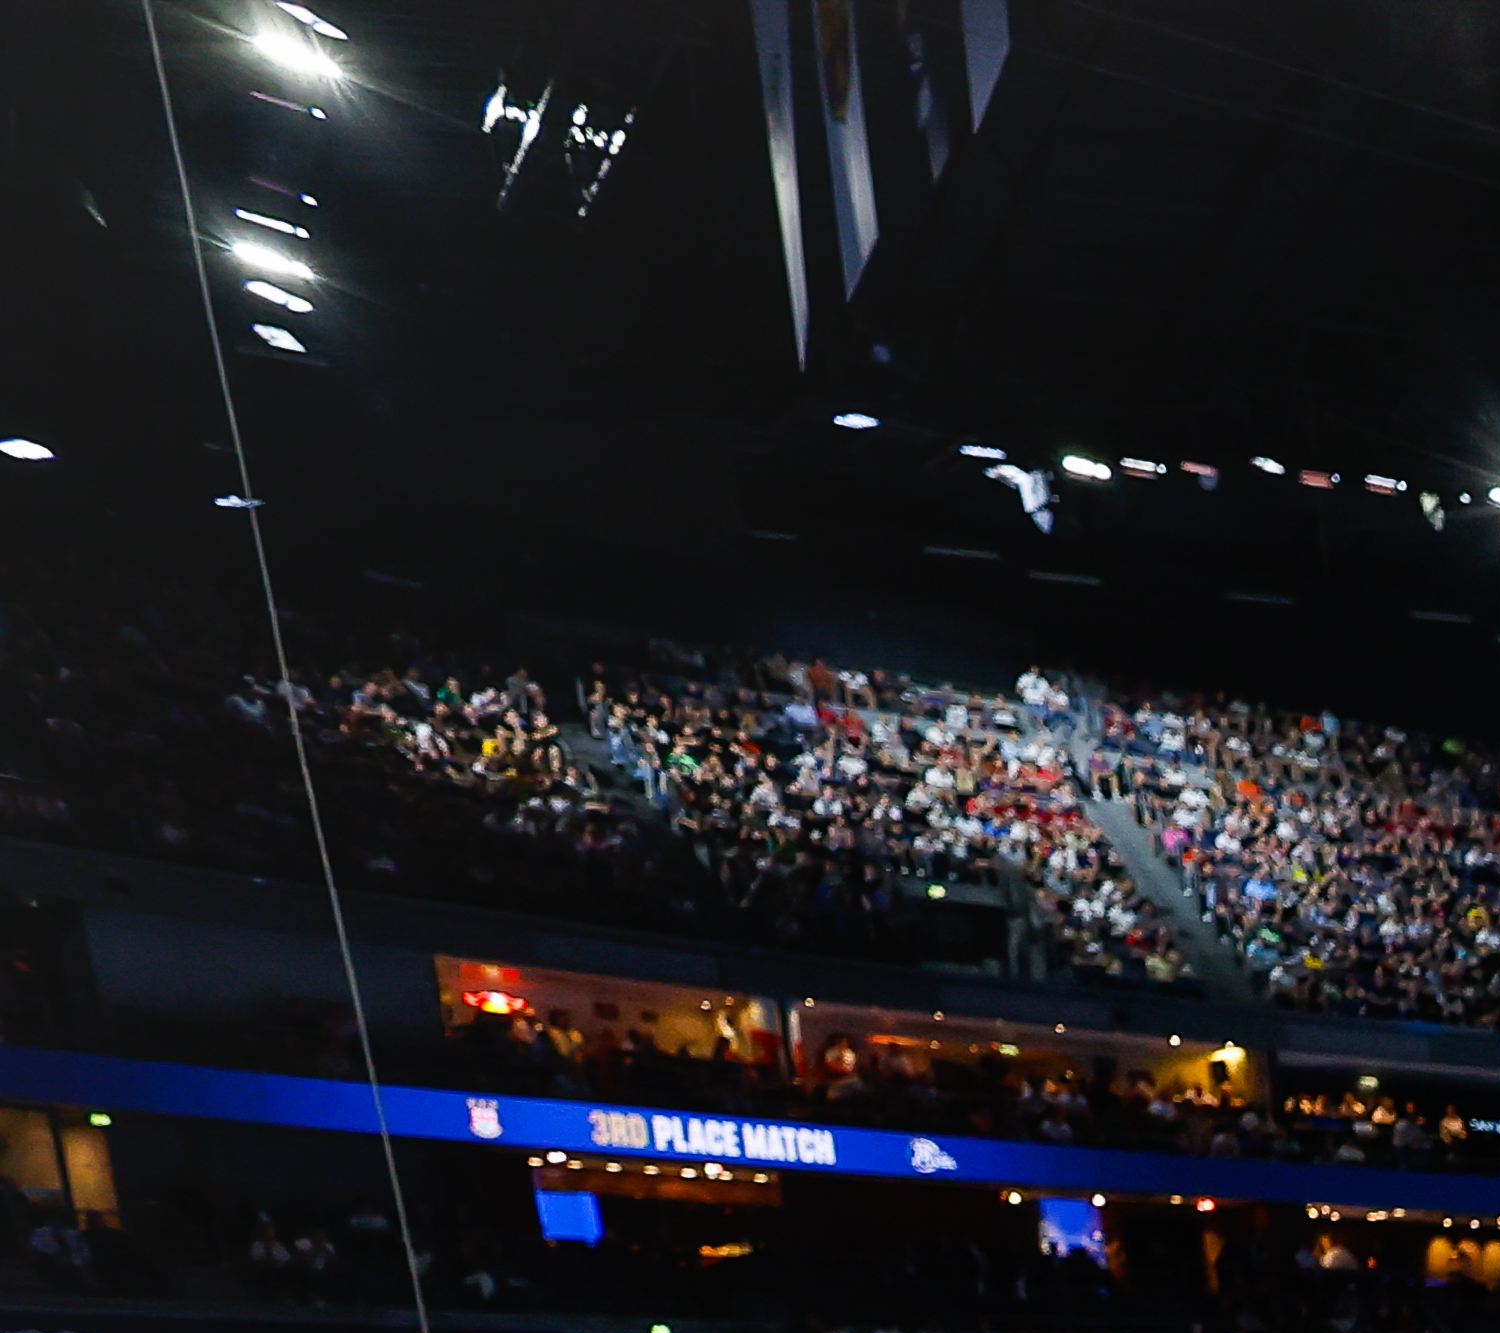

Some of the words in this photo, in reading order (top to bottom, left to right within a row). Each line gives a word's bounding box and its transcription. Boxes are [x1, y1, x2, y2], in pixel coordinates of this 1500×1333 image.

[588, 1108, 649, 1149] 3RD
[652, 1114, 742, 1157] PLACE
[742, 1123, 838, 1166] MATCH
